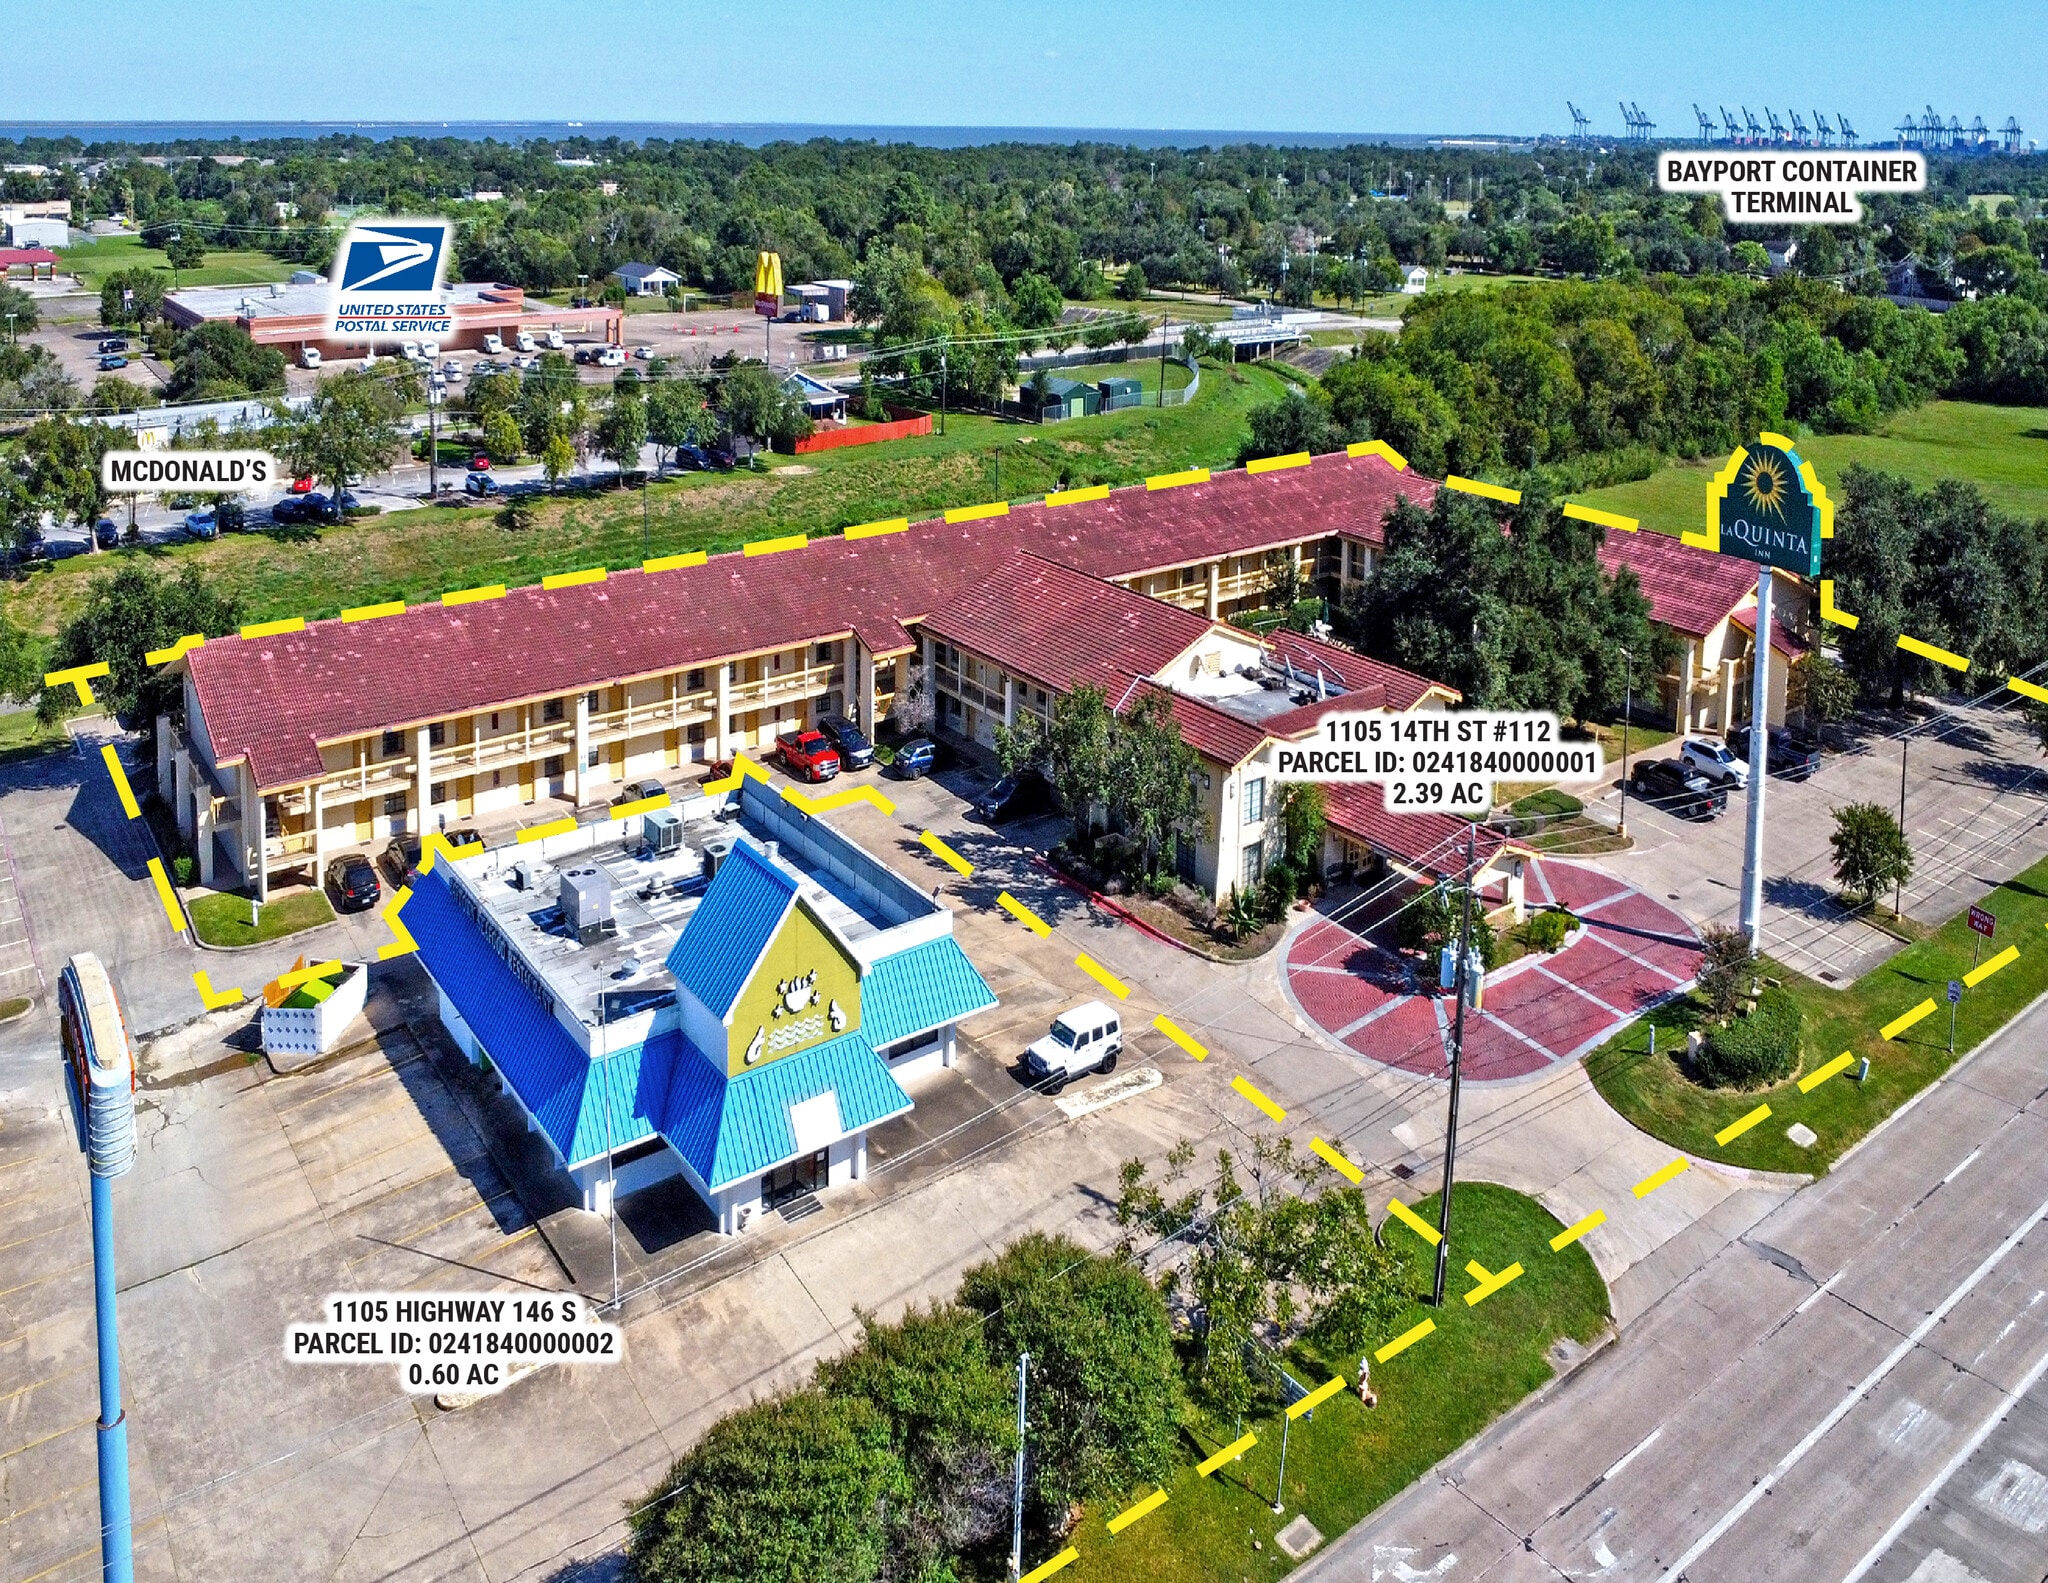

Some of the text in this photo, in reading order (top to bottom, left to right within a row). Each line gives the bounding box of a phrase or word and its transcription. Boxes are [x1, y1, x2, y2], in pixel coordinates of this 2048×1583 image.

[1734, 519, 1808, 555] QUINTA
[1754, 548, 1771, 560] INN
[1971, 908, 1994, 926] WRONG
[1973, 920, 1987, 933] WAY
